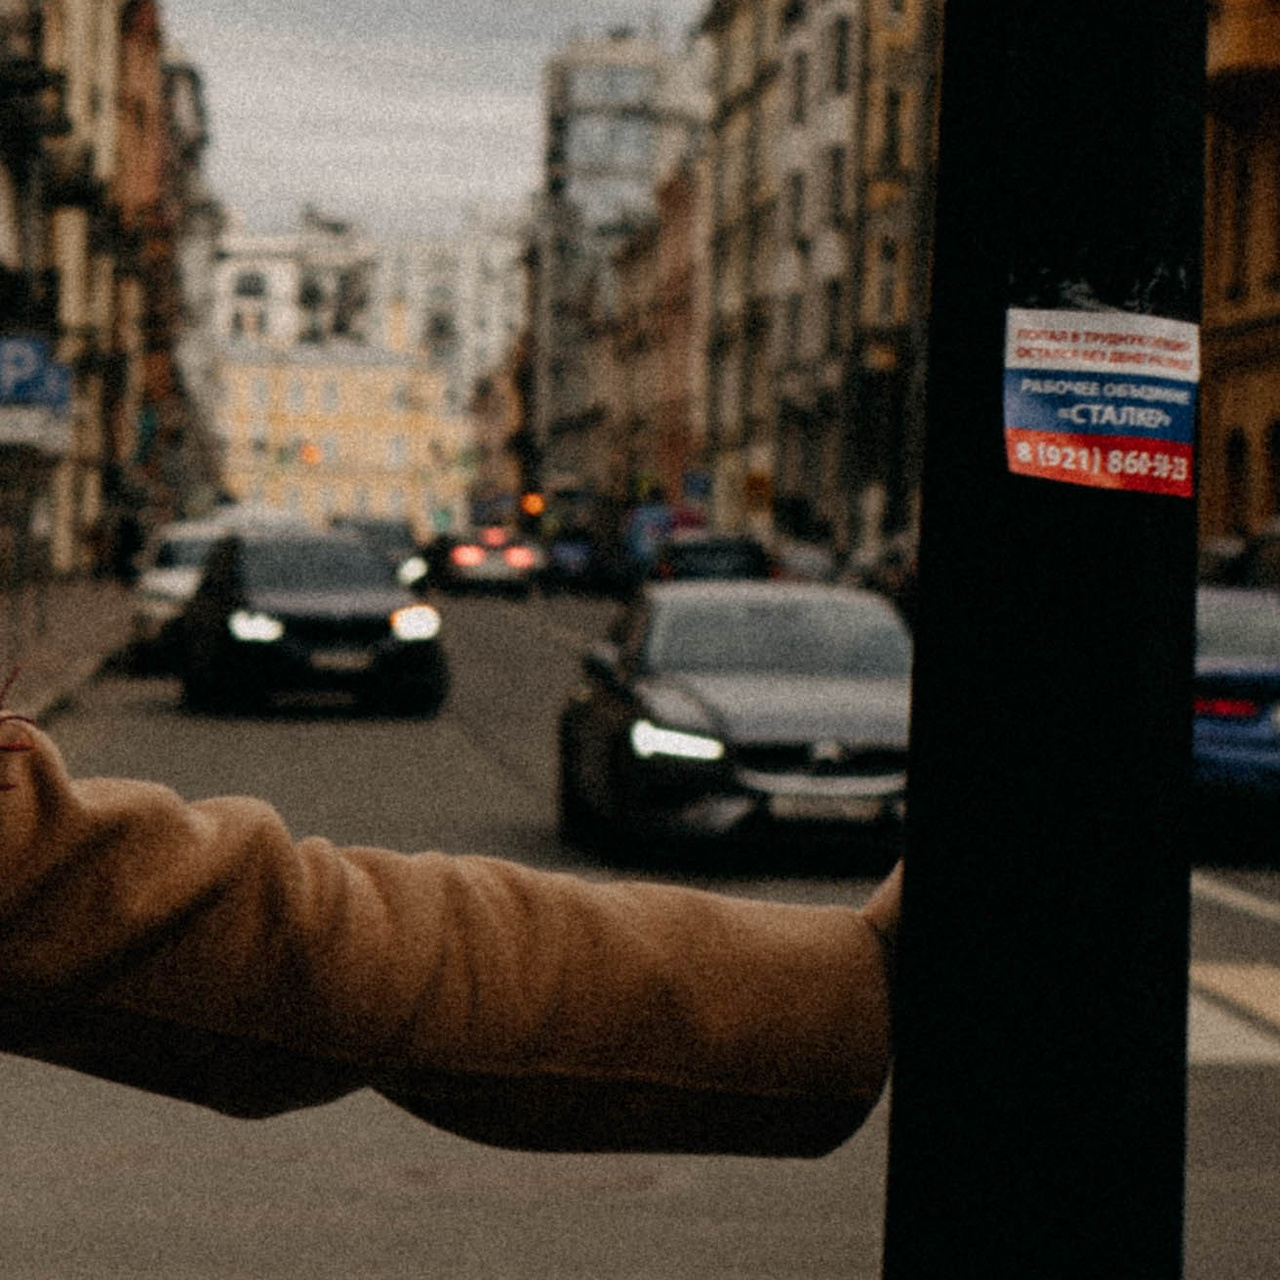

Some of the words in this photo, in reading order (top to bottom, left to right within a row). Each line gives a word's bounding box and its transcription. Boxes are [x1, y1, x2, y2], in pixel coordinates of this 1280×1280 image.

[1020, 378, 1101, 397] РАБОЧЕЕ
[1015, 441, 1032, 463] 8
[1037, 441, 1101, 476] (921)
